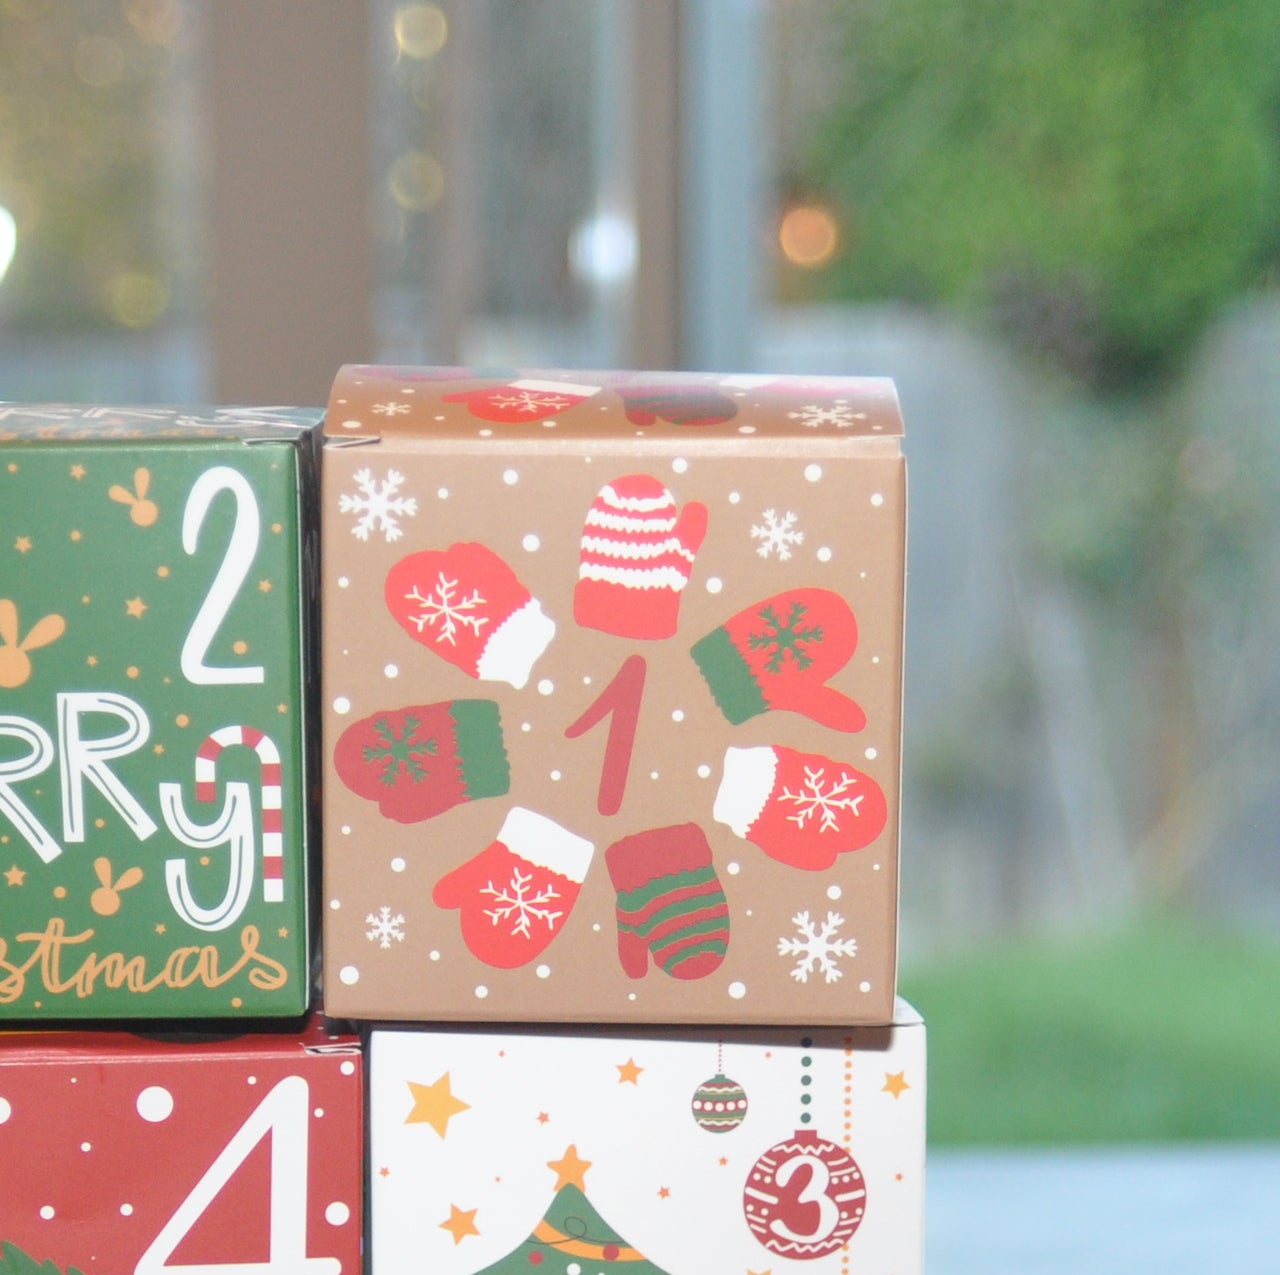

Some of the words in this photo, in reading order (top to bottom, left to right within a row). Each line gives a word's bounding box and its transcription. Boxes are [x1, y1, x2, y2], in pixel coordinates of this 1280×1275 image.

[181, 466, 263, 684] 2
[565, 654, 646, 816] 1
[770, 1154, 839, 1243] 3
